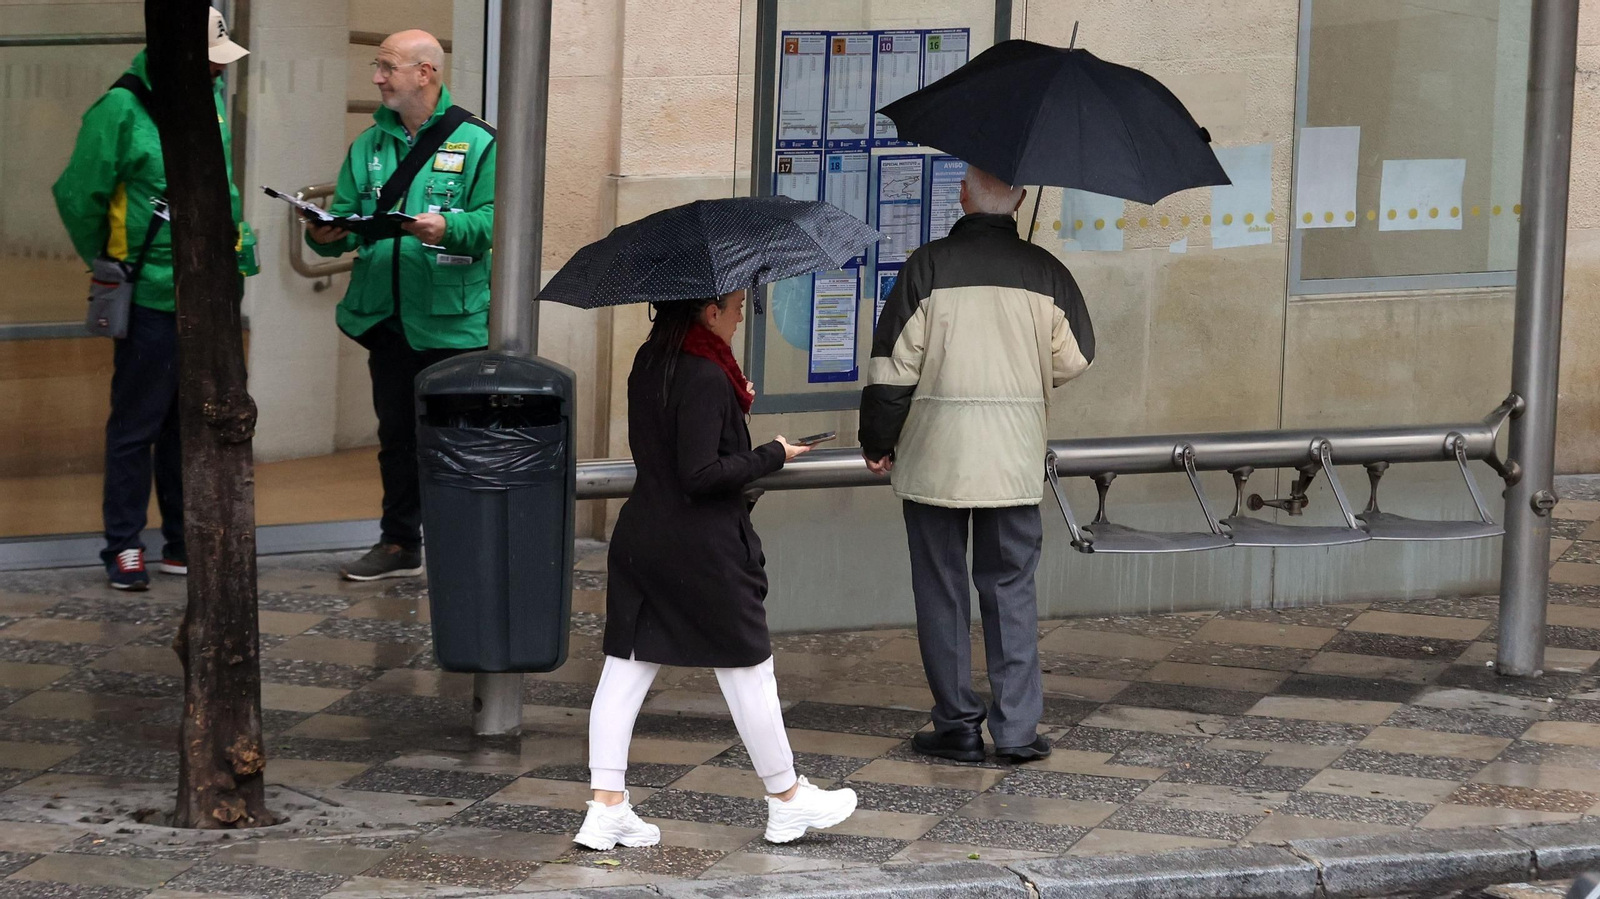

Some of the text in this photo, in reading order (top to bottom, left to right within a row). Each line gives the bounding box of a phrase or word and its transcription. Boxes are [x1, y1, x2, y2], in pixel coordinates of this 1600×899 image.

[790, 44, 794, 52] 2
[836, 44, 842, 52] 3
[930, 42, 939, 50] 16
[781, 164, 790, 172] 17
[830, 162, 840, 170] 18
